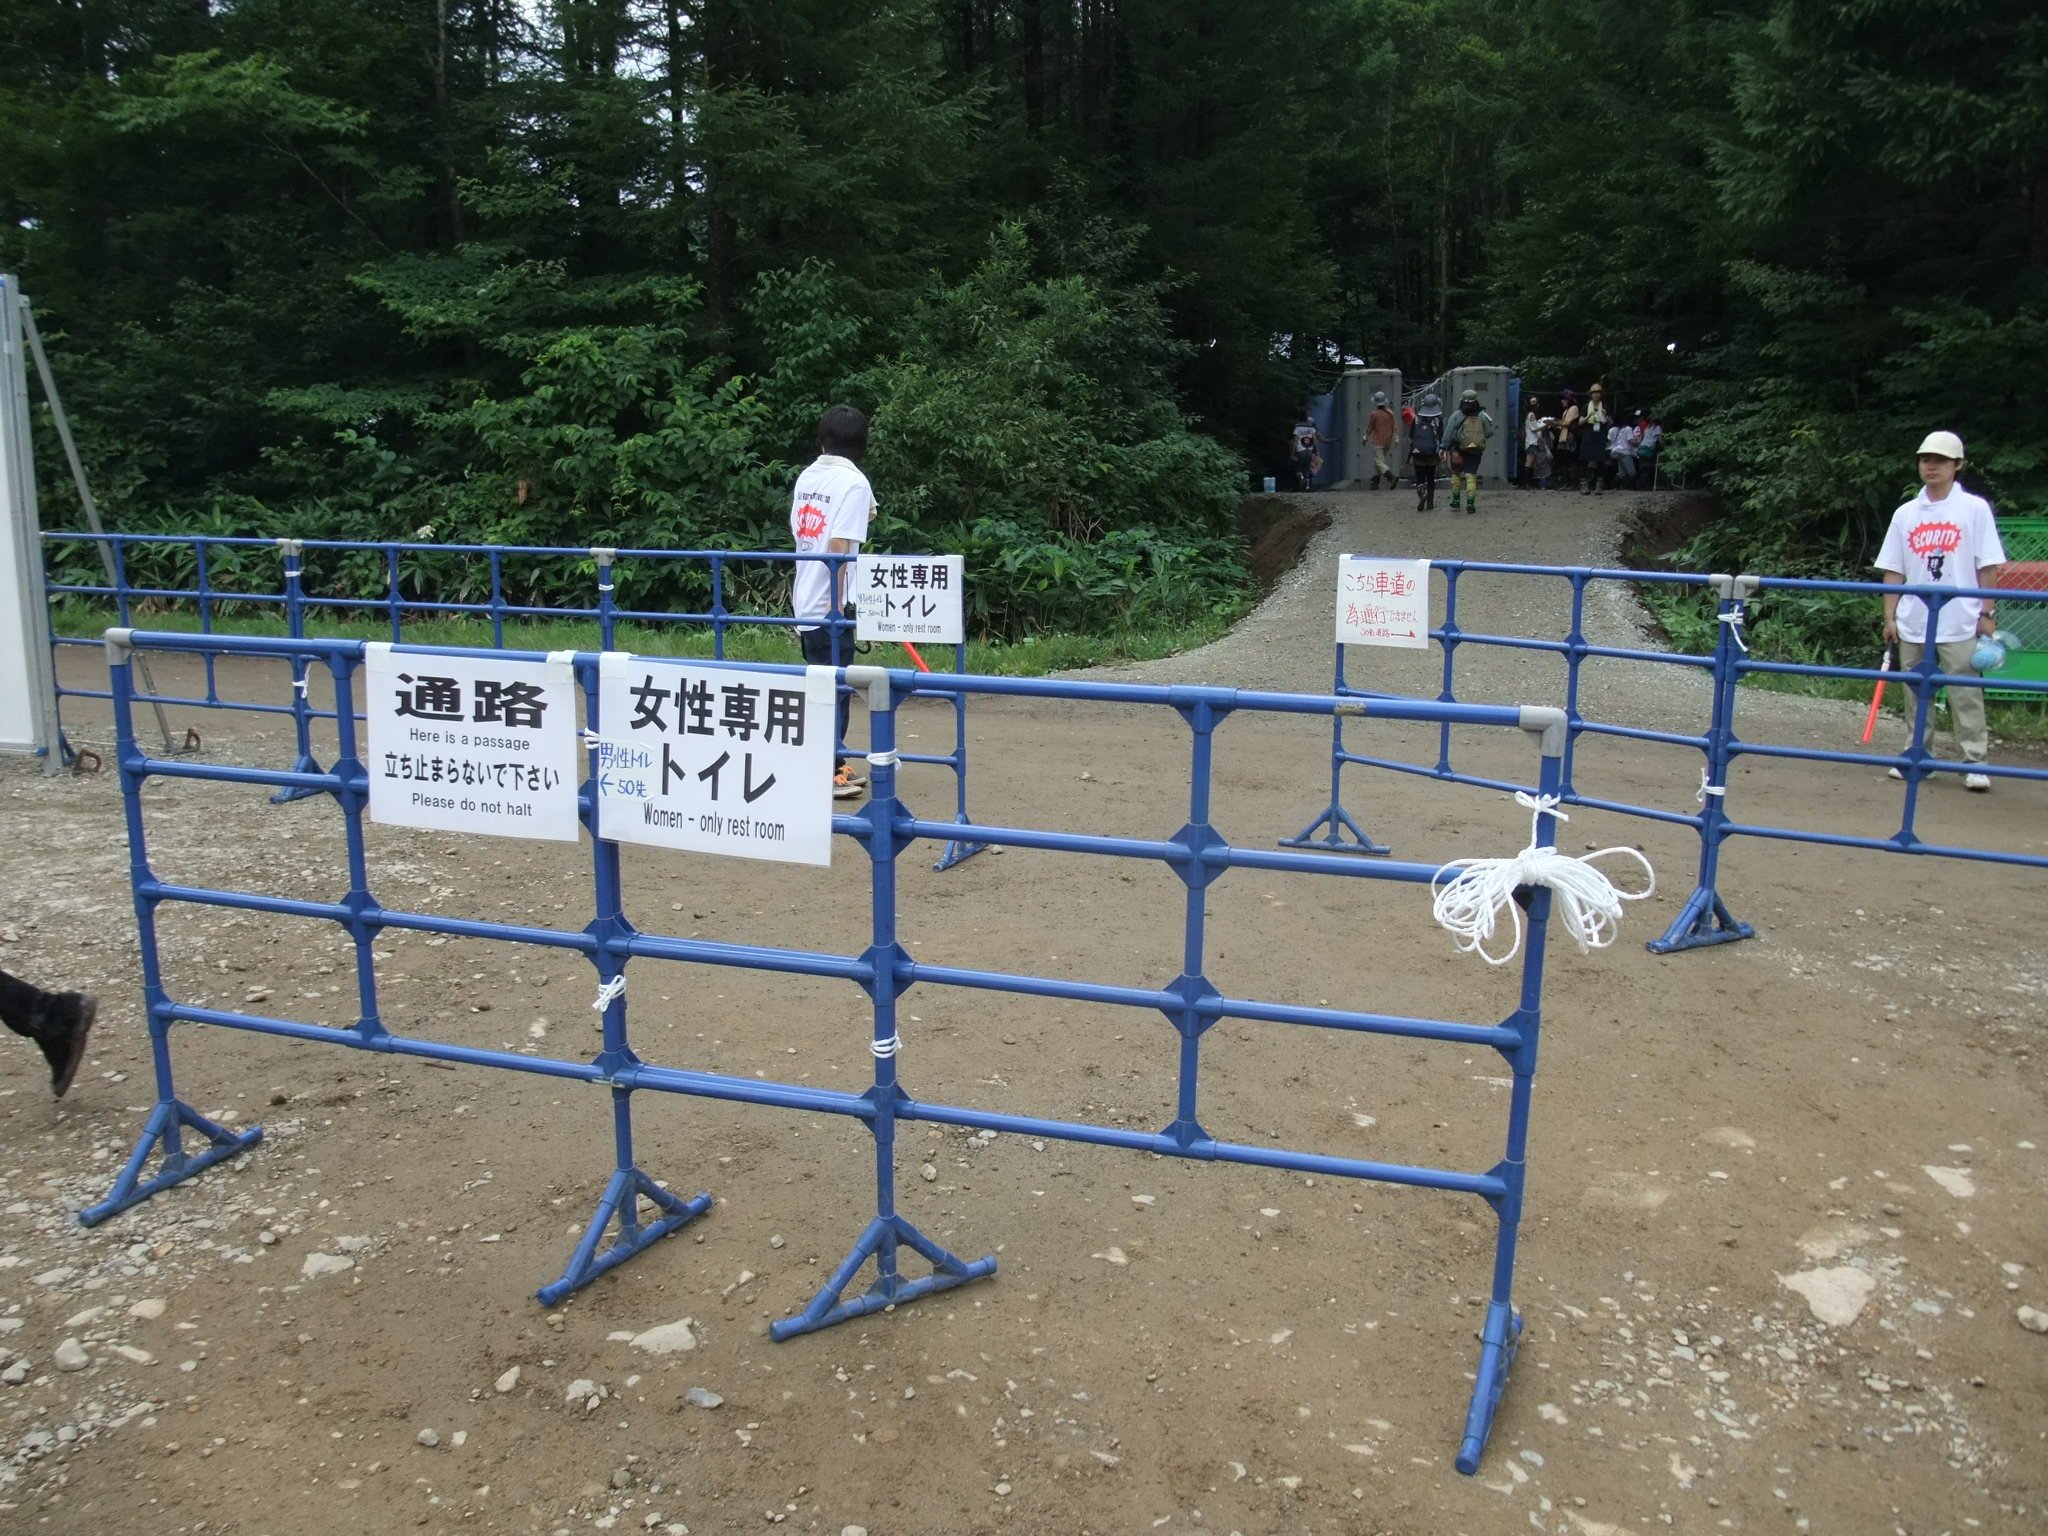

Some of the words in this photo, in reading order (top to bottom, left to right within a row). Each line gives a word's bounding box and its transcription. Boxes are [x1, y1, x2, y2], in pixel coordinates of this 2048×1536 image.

[870, 563, 948, 590] 女性専用
[1345, 570, 1416, 598] こちら車道の
[885, 593, 936, 618] トイレ
[877, 621, 895, 632] Women
[903, 623, 913, 634] only
[915, 623, 926, 633] rest
[927, 625, 941, 634] room
[394, 672, 549, 729] 通路
[629, 674, 806, 747] 女性専用
[410, 728, 440, 743] Here
[445, 731, 456, 744] is
[461, 735, 469, 745] a
[474, 735, 530, 751] passage
[600, 742, 653, 770] 男性トイレ
[385, 751, 560, 792] 立ち止まらないで下さい
[661, 742, 777, 804] トイレ
[412, 792, 455, 809] Please
[460, 798, 476, 811] do
[481, 800, 502, 814] not
[507, 802, 533, 817] halt
[643, 802, 683, 829] Women
[700, 811, 723, 836] only
[727, 816, 750, 837] rest
[755, 821, 785, 841] room
